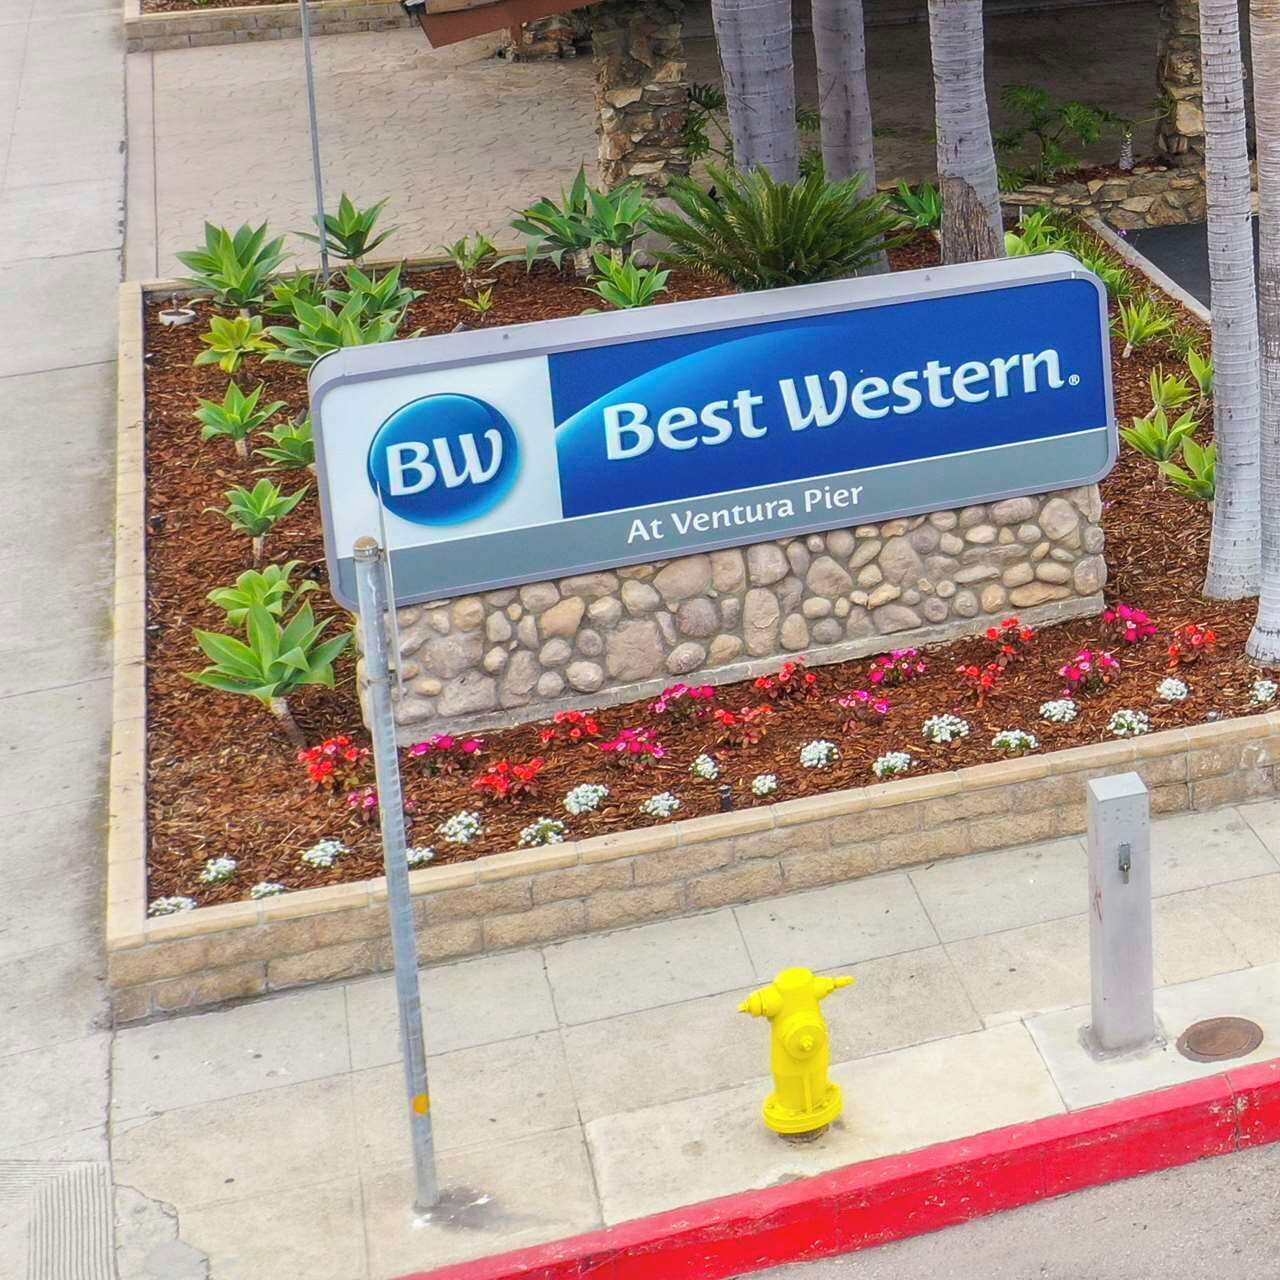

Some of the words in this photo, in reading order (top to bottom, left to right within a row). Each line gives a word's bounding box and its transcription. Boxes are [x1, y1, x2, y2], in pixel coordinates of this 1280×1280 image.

[603, 389, 768, 460] Best
[386, 428, 503, 497] BW
[627, 518, 665, 544] At
[671, 497, 795, 535] Ventura
[803, 484, 864, 513] Pier
